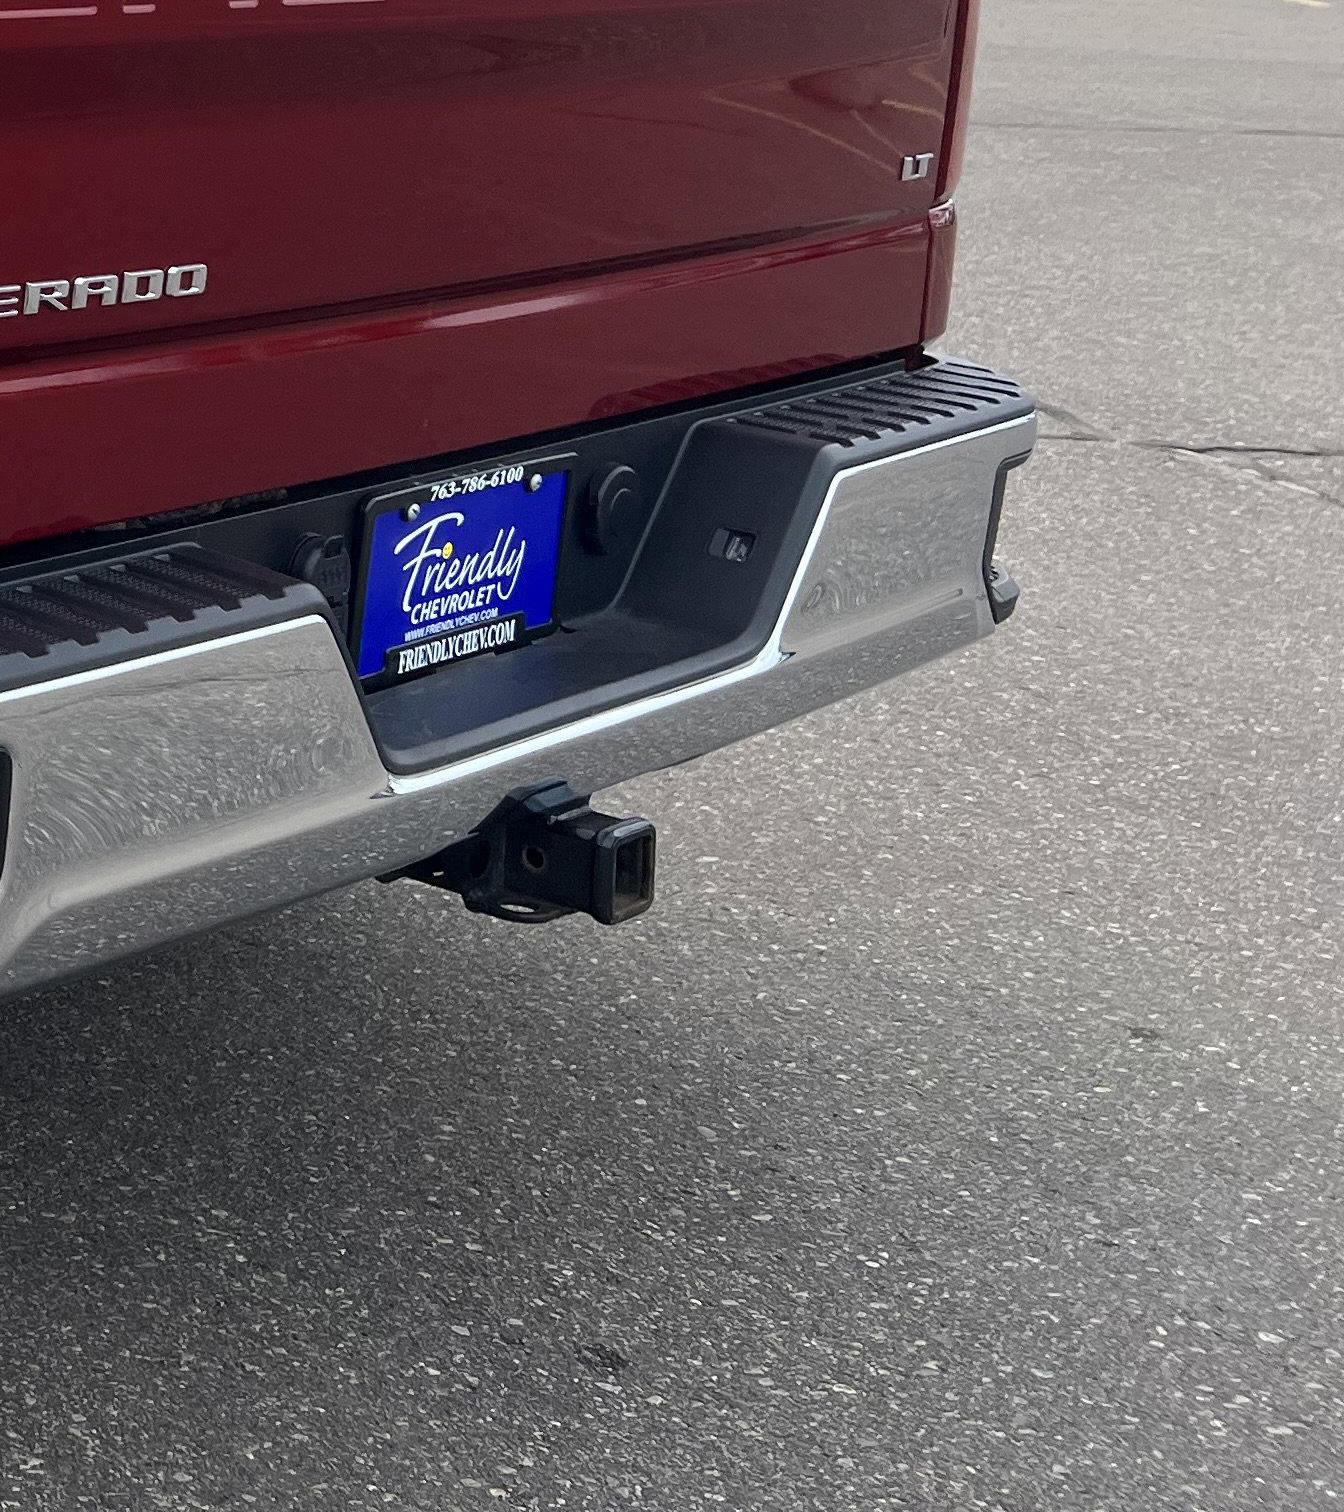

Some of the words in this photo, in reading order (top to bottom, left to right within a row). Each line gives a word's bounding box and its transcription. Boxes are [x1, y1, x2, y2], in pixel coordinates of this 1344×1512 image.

[901, 152, 934, 181] LT
[430, 466, 525, 501] 763-786-6100
[393, 512, 526, 613] Friendly
[410, 584, 496, 625] CHEVROLET
[404, 607, 499, 642] WWW.FRIENDLYCHEV.COM
[397, 619, 516, 675] FRIENDLYCHEV.COM
